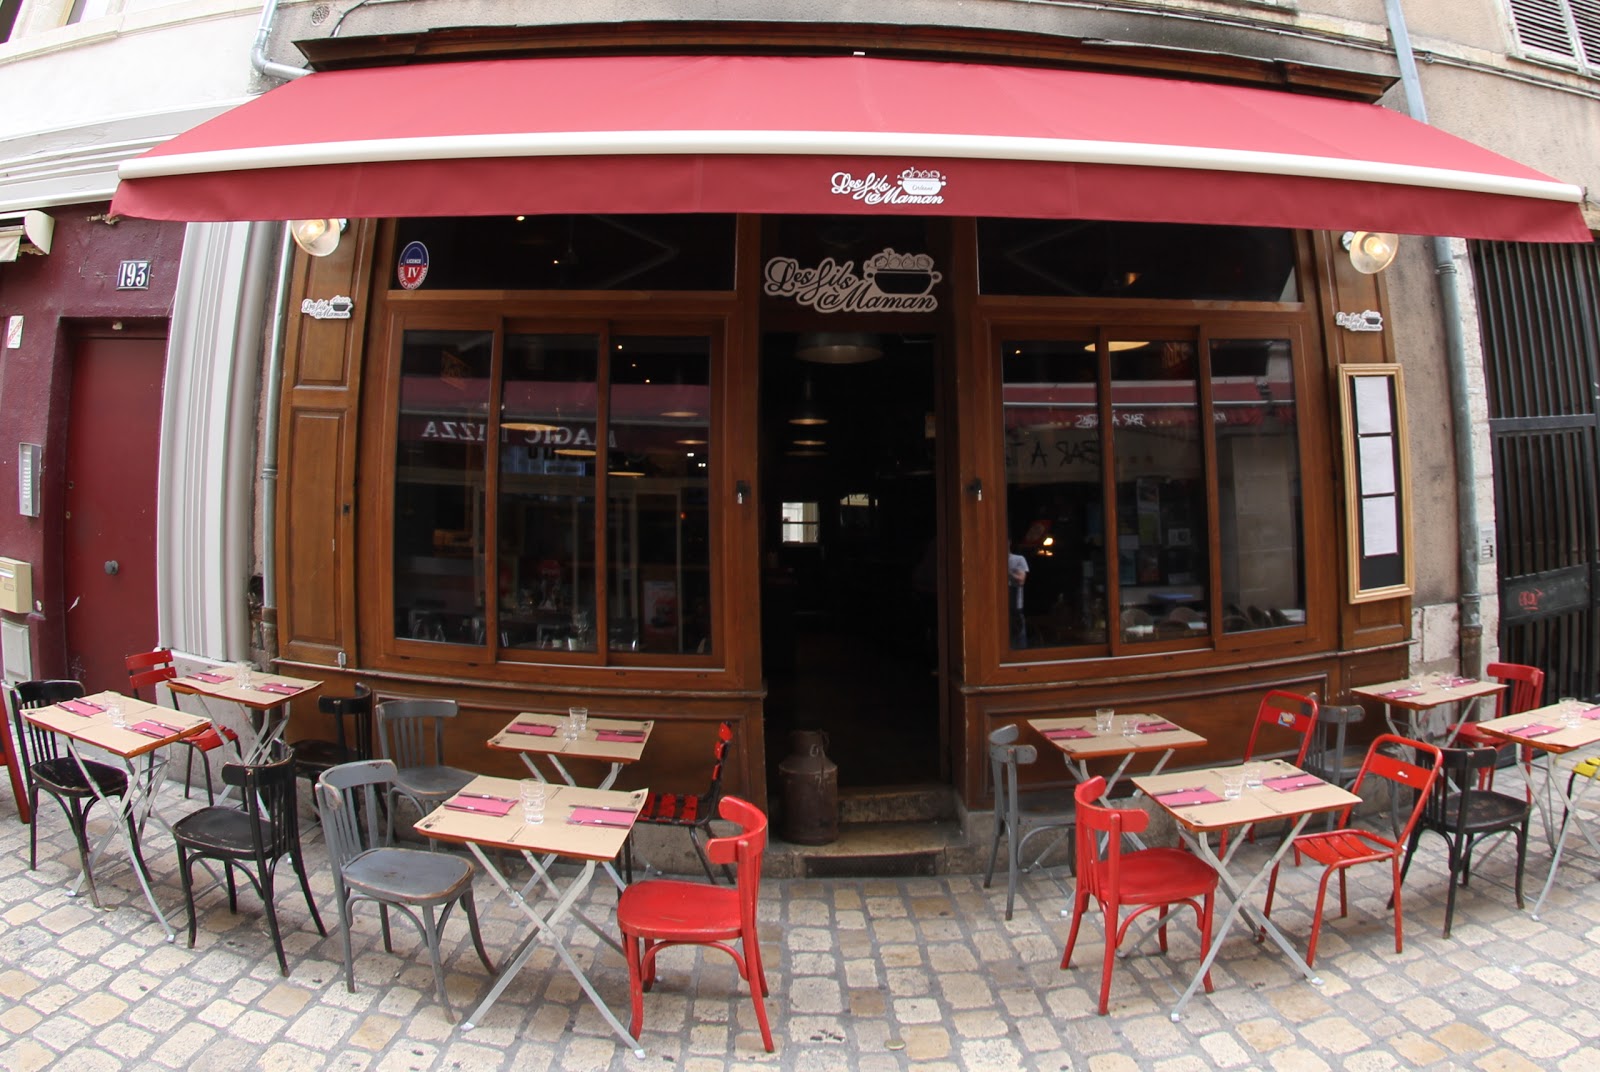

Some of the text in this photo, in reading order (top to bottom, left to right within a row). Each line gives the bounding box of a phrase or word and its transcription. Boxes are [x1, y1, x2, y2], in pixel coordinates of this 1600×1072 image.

[831, 172, 890, 200] Les fils
[878, 187, 944, 204] Maman
[120, 262, 148, 287] 193
[407, 267, 420, 278] IV
[767, 260, 857, 302] Les fils
[840, 282, 938, 310] Maman
